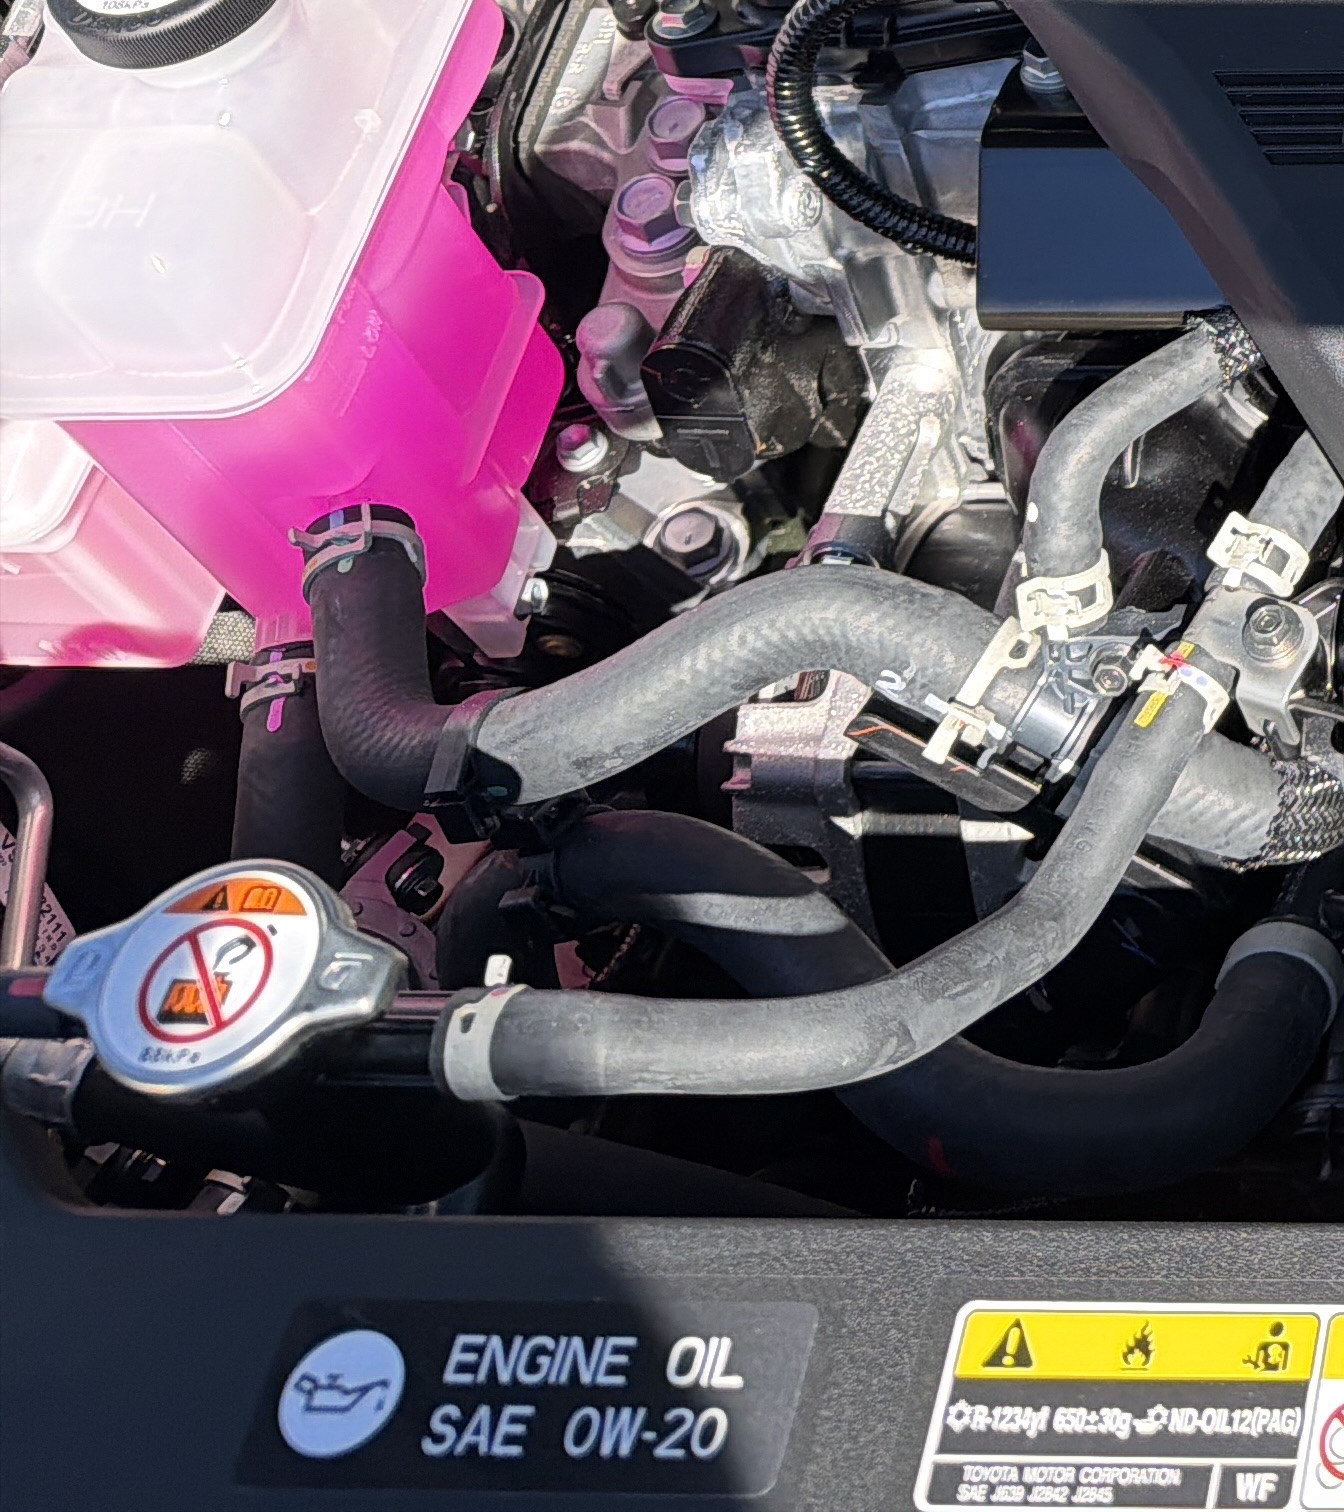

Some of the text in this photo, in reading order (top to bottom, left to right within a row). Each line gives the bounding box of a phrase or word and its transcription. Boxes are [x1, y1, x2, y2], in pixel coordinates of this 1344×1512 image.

[442, 1334, 744, 1389] ENGINE OIL
[421, 1403, 728, 1459] SAE 0W-20
[1053, 1408, 1132, 1439] 650±30g
[1168, 1408, 1301, 1438] ND-OIL12(PAG)
[963, 1465, 1181, 1485] TOYOTA MOTOR CORPORATION
[1236, 1472, 1276, 1502] WF
[957, 1485, 988, 1501] SAE
